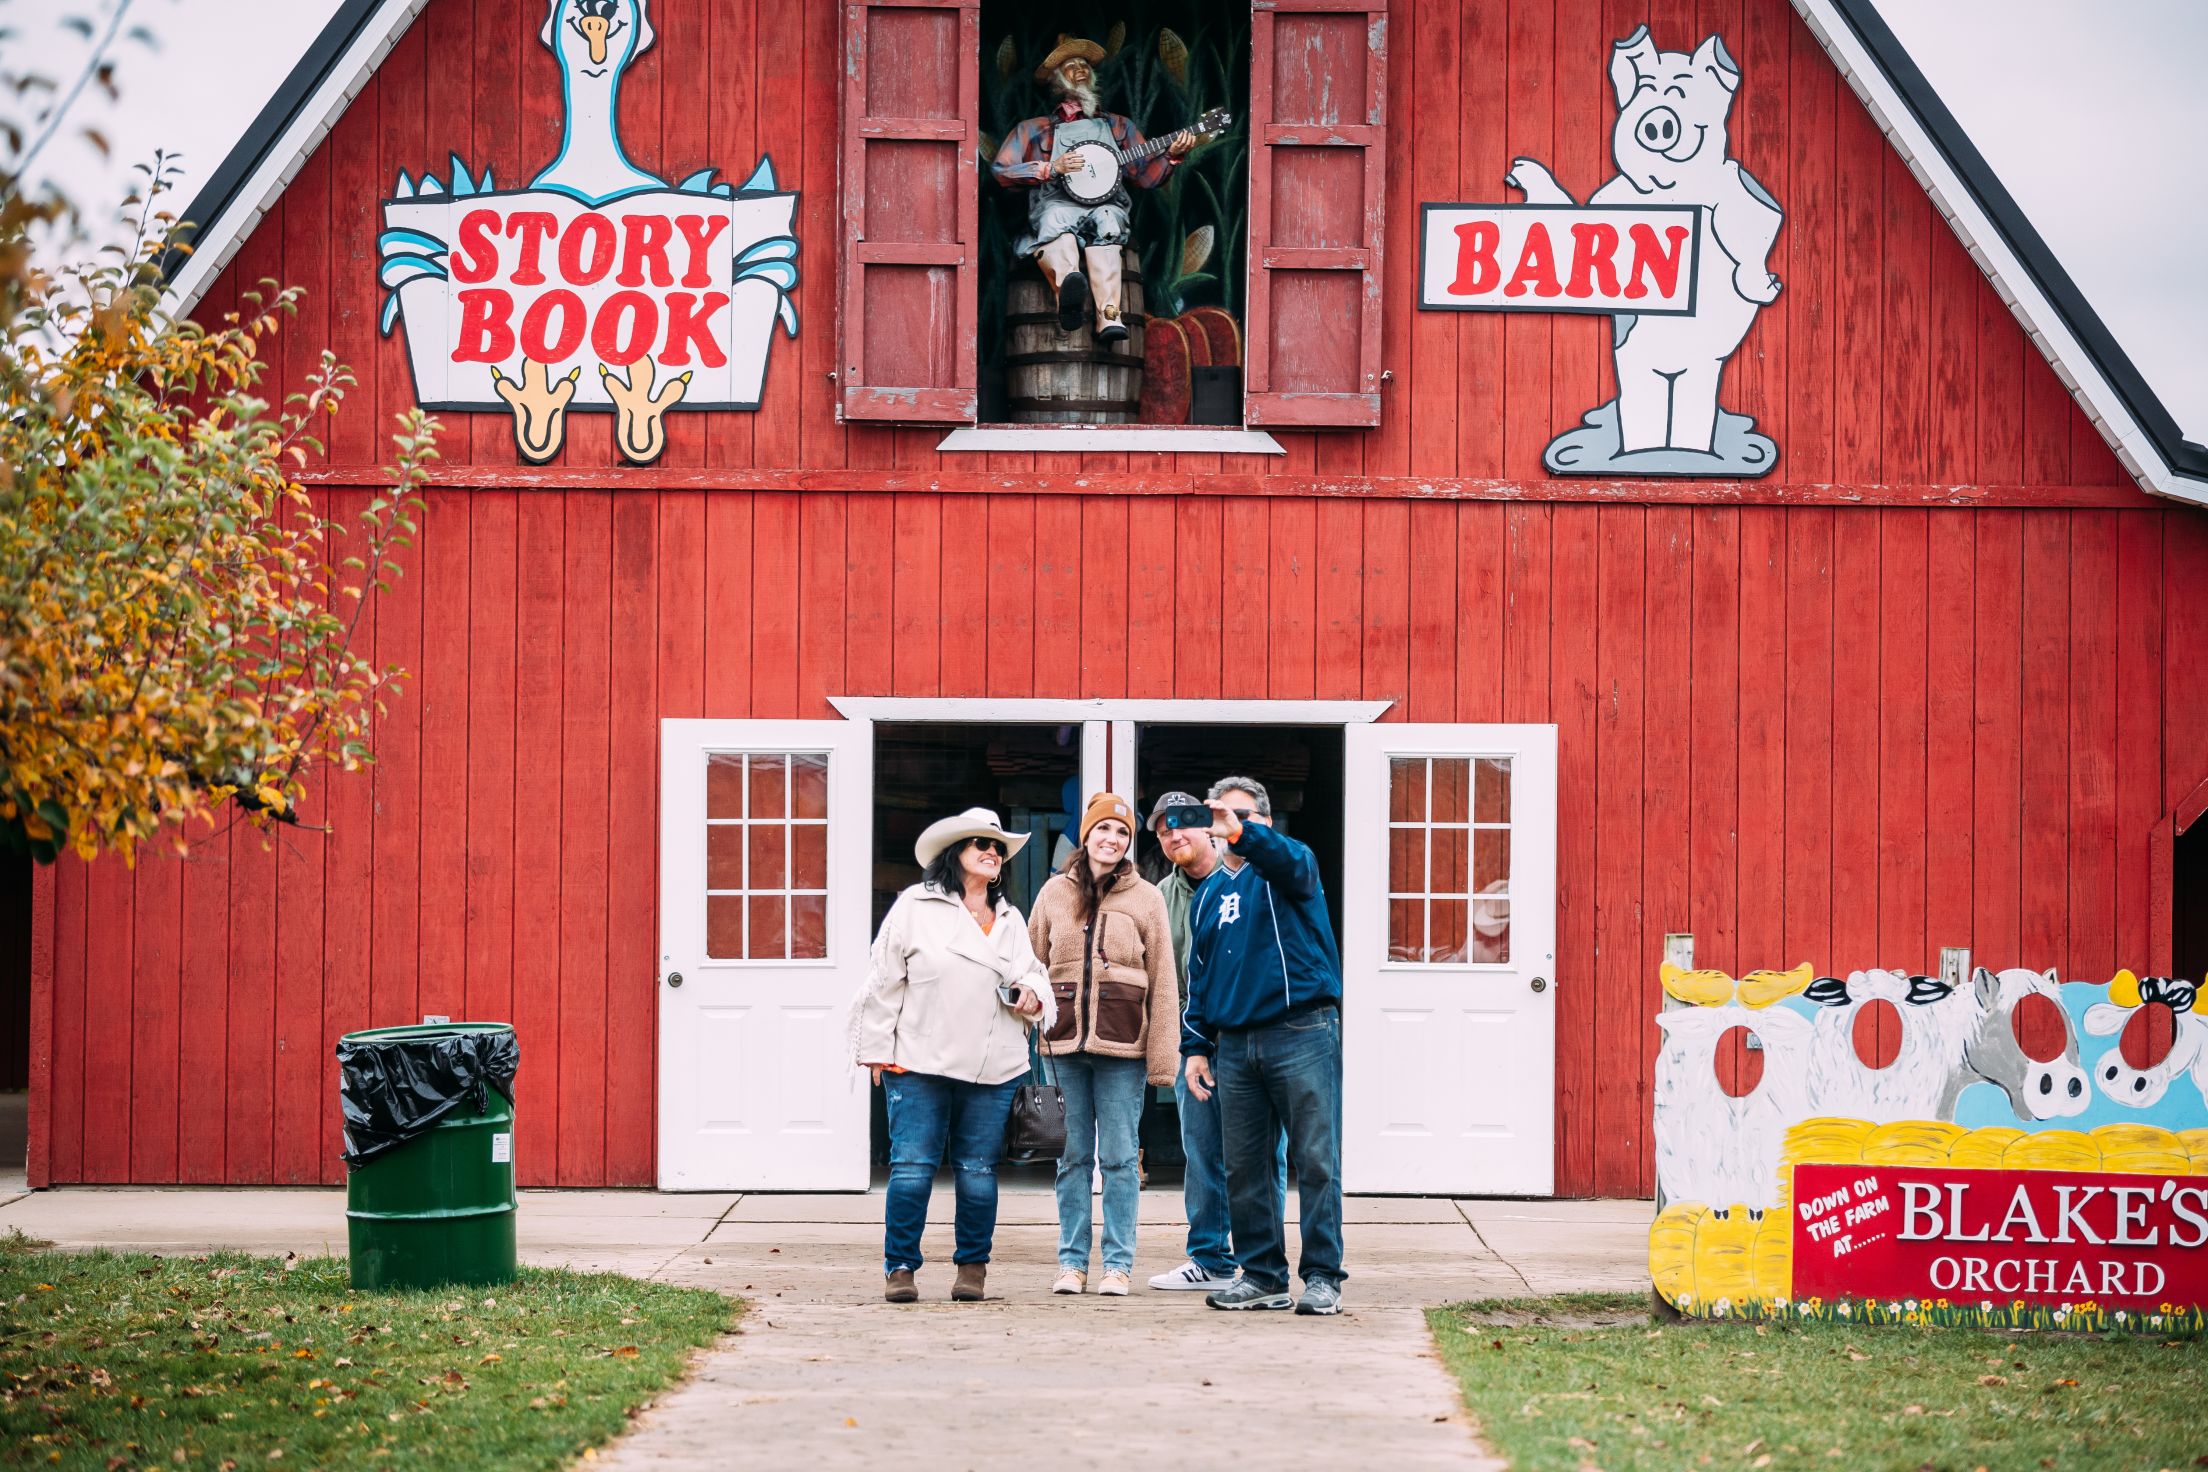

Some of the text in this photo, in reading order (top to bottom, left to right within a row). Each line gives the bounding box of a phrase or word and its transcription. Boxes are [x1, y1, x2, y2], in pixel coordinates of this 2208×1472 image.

[450, 209, 730, 288] STORY
[1447, 220, 1690, 300] BARN
[450, 288, 731, 368] BOOK
[1798, 1175, 1879, 1221] DOWN ON
[1806, 1195, 1890, 1242] THE FARM
[1896, 1179, 2208, 1248] BLAKE'S
[1929, 1256, 2166, 1296] ORCHARD
